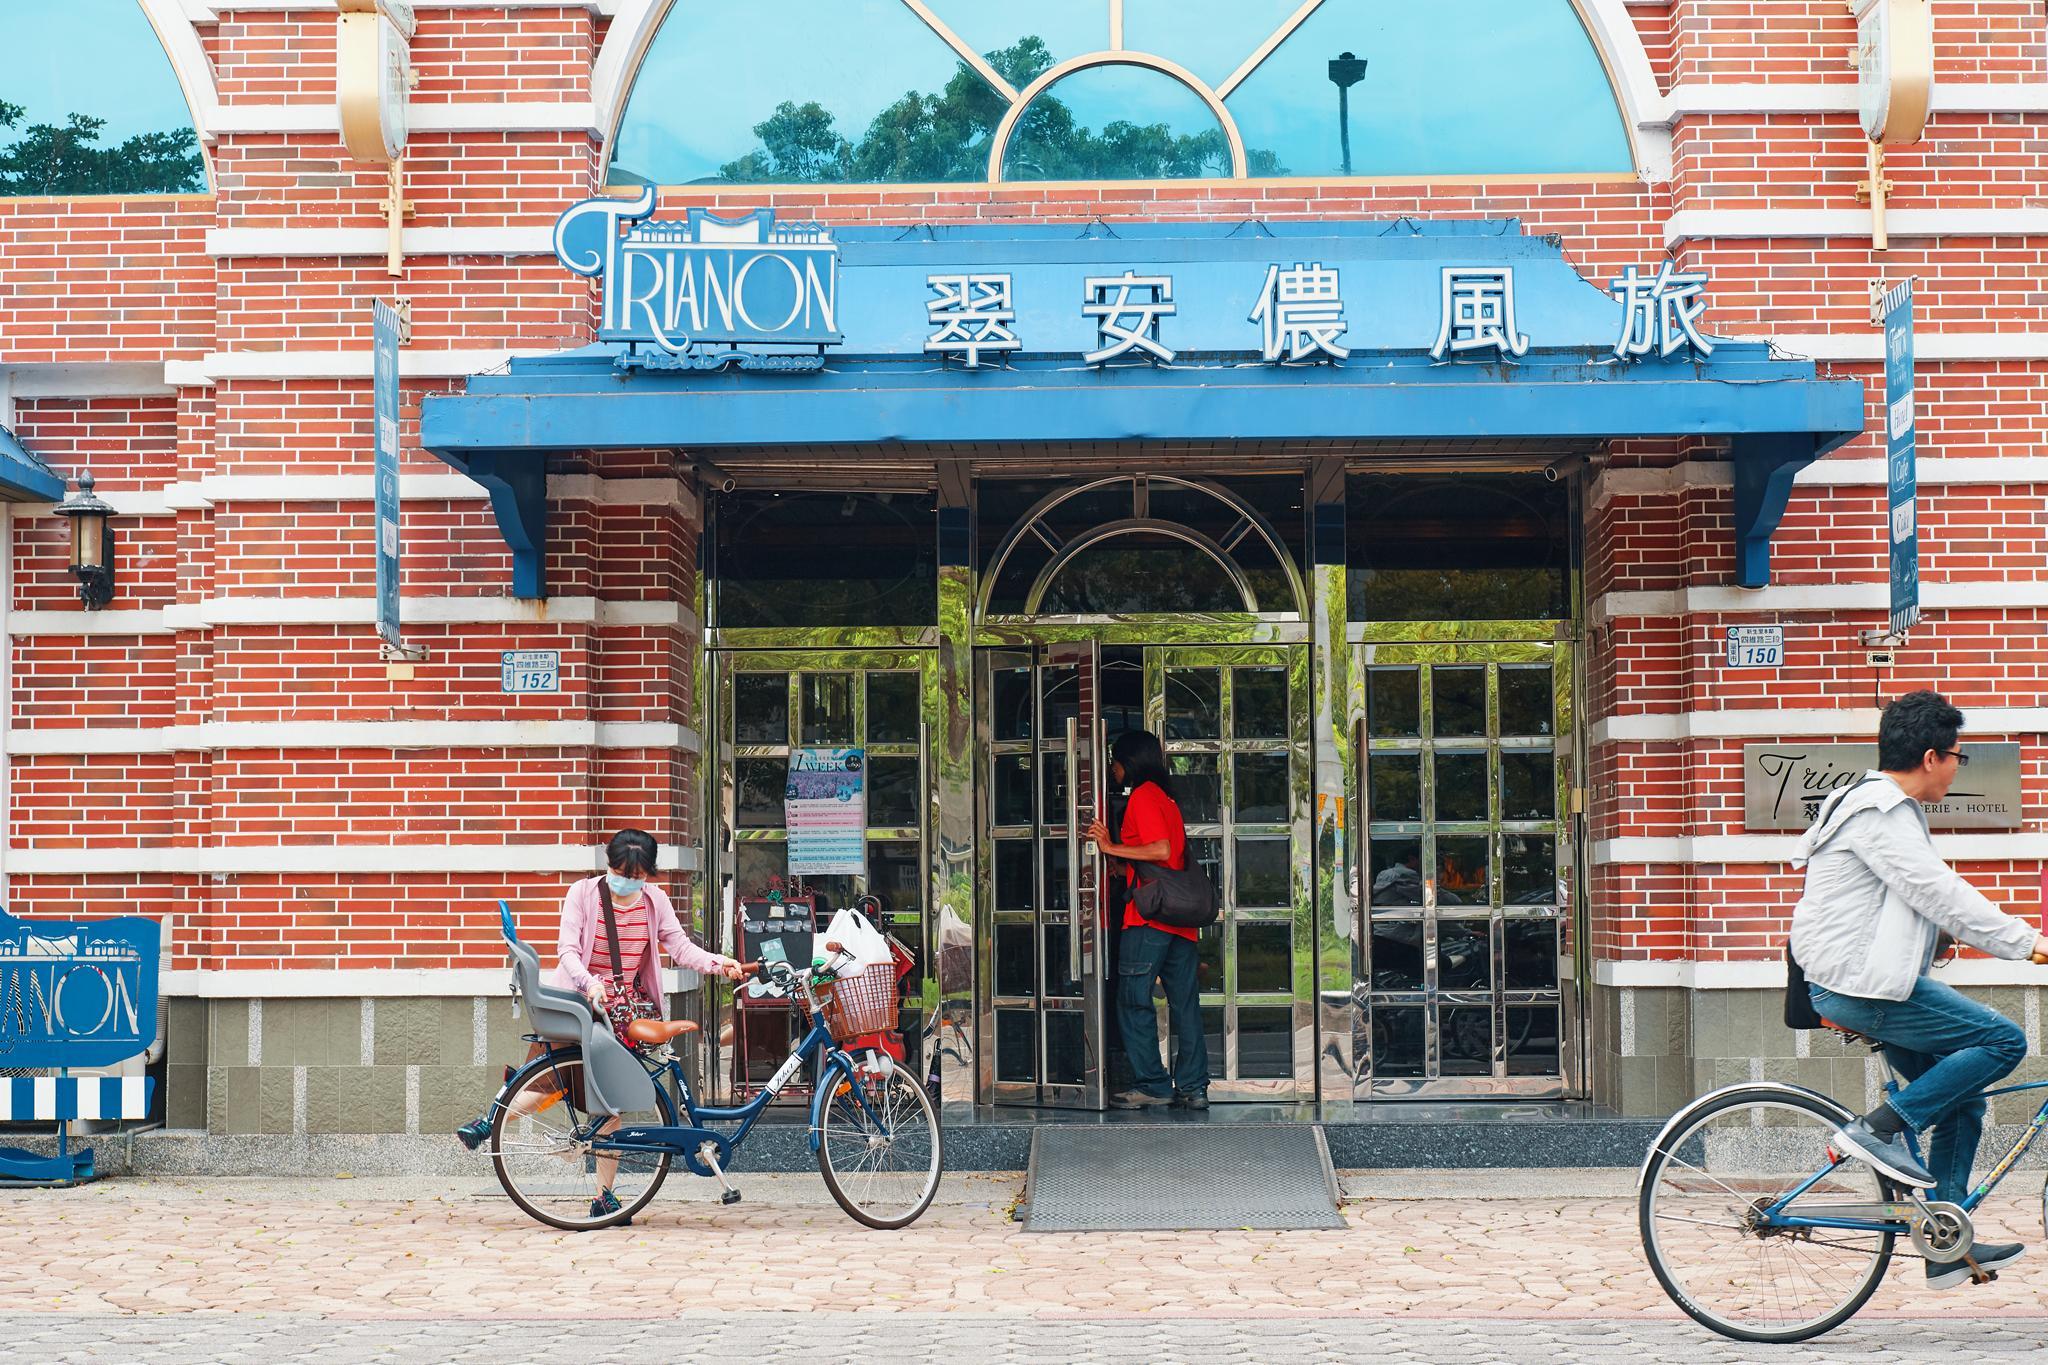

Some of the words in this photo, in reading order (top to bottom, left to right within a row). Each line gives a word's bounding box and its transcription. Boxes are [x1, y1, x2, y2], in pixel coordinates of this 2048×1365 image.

[555, 186, 837, 351] TRIANON
[925, 260, 1715, 367] 翠安儂風旅
[521, 673, 551, 688] 152
[1746, 648, 1776, 663] 150
[1759, 753, 1866, 820] Tria
[1967, 803, 2008, 813] HOTEL
[0, 965, 141, 1035] ANON
